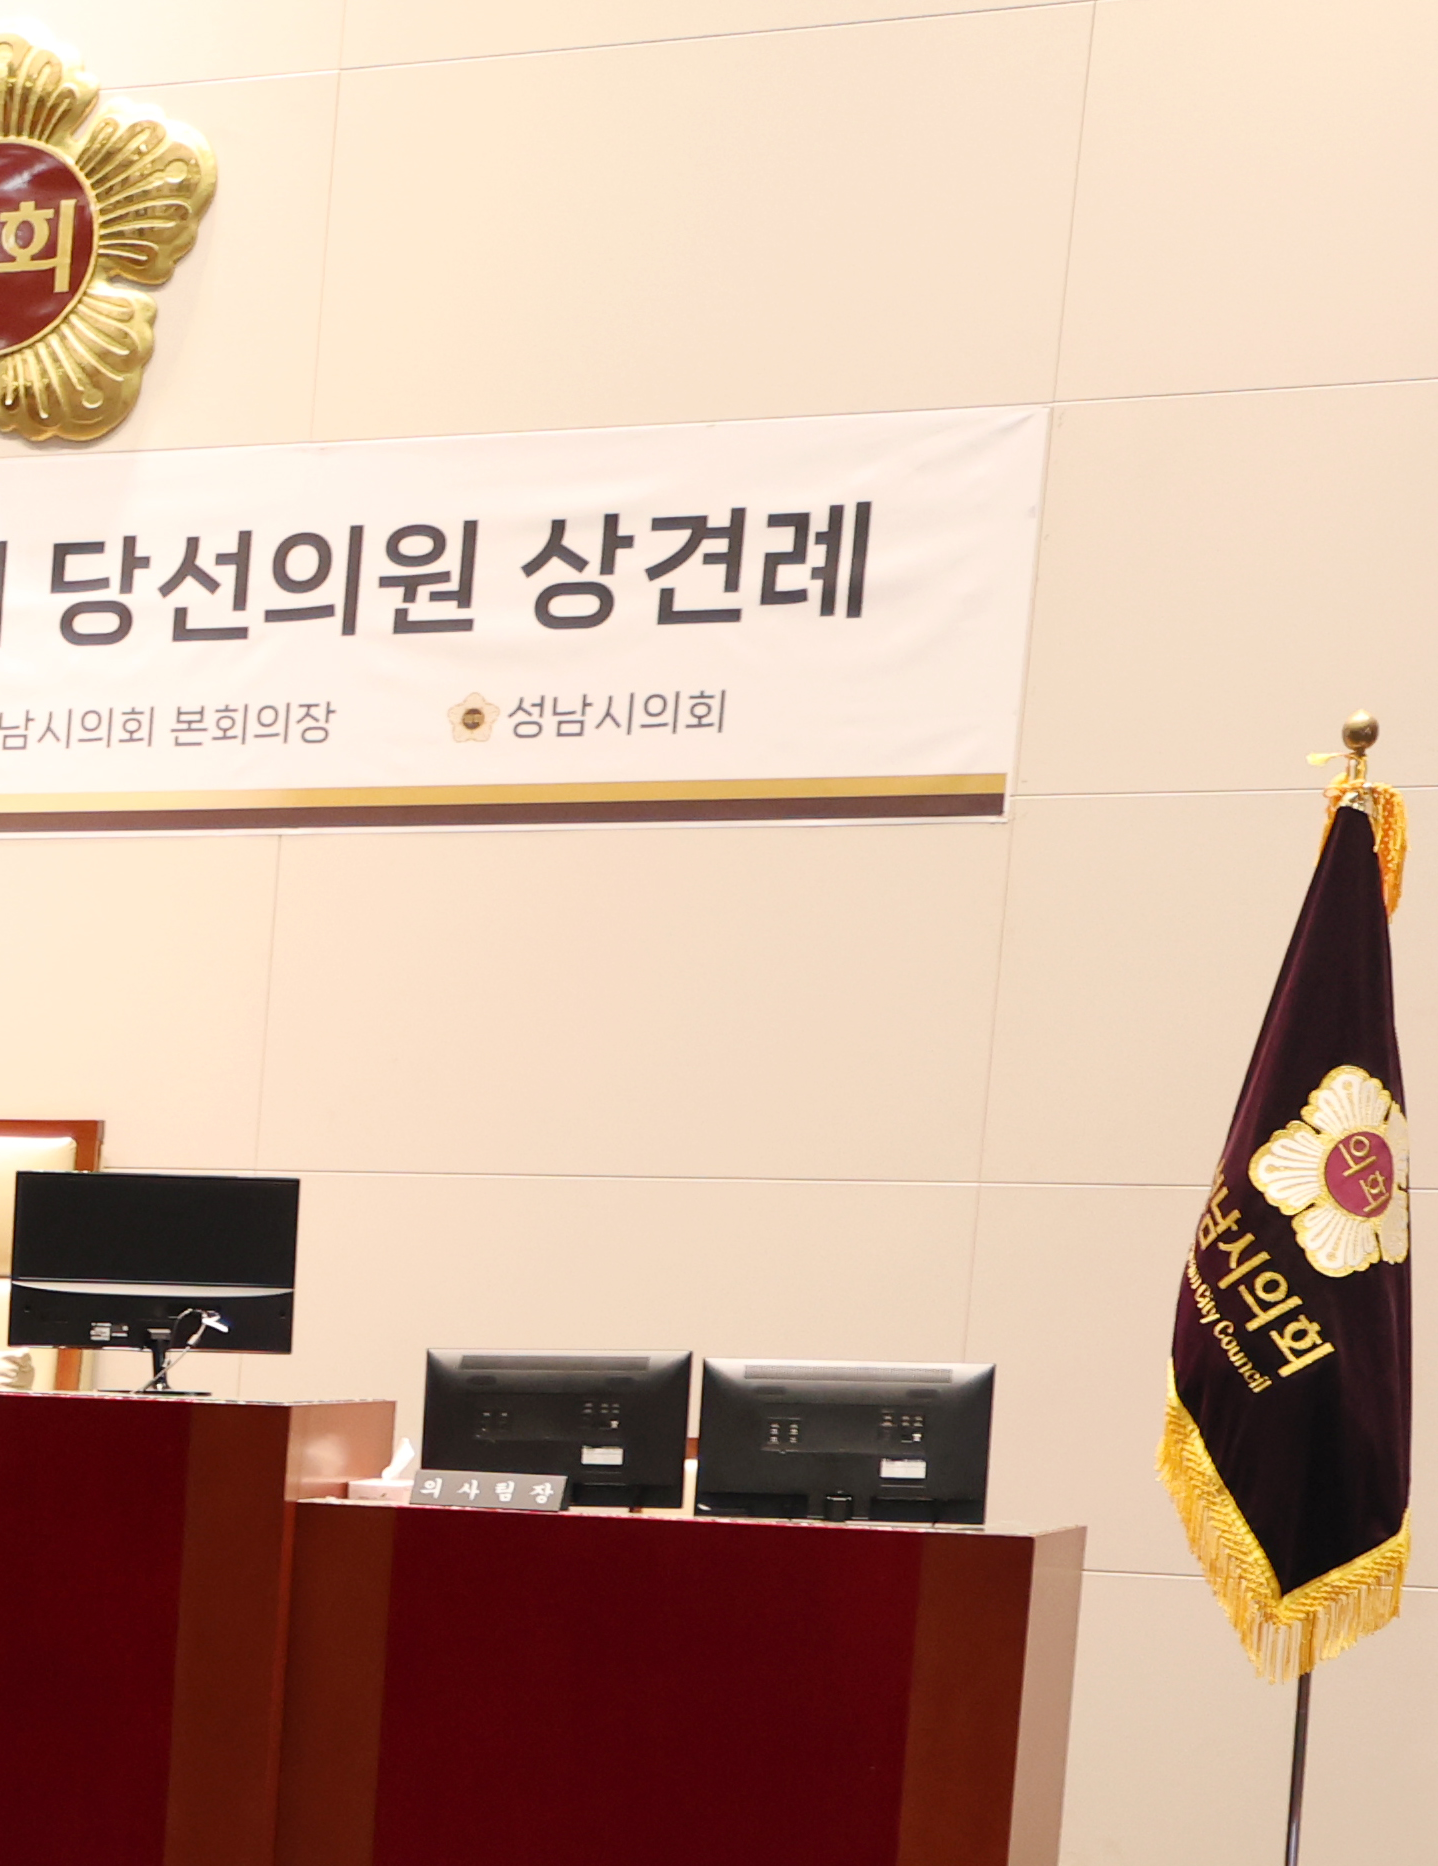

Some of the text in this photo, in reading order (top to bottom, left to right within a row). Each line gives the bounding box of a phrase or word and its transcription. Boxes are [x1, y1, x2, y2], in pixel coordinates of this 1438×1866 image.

[48, 519, 480, 648] 당선의원
[521, 500, 873, 631] 상견례
[170, 700, 336, 746] 본회의장
[508, 689, 726, 739] 성남시의회
[1339, 1136, 1389, 1212] 의회
[1198, 1159, 1335, 1377] 남시의회
[1213, 1320, 1272, 1393] Council
